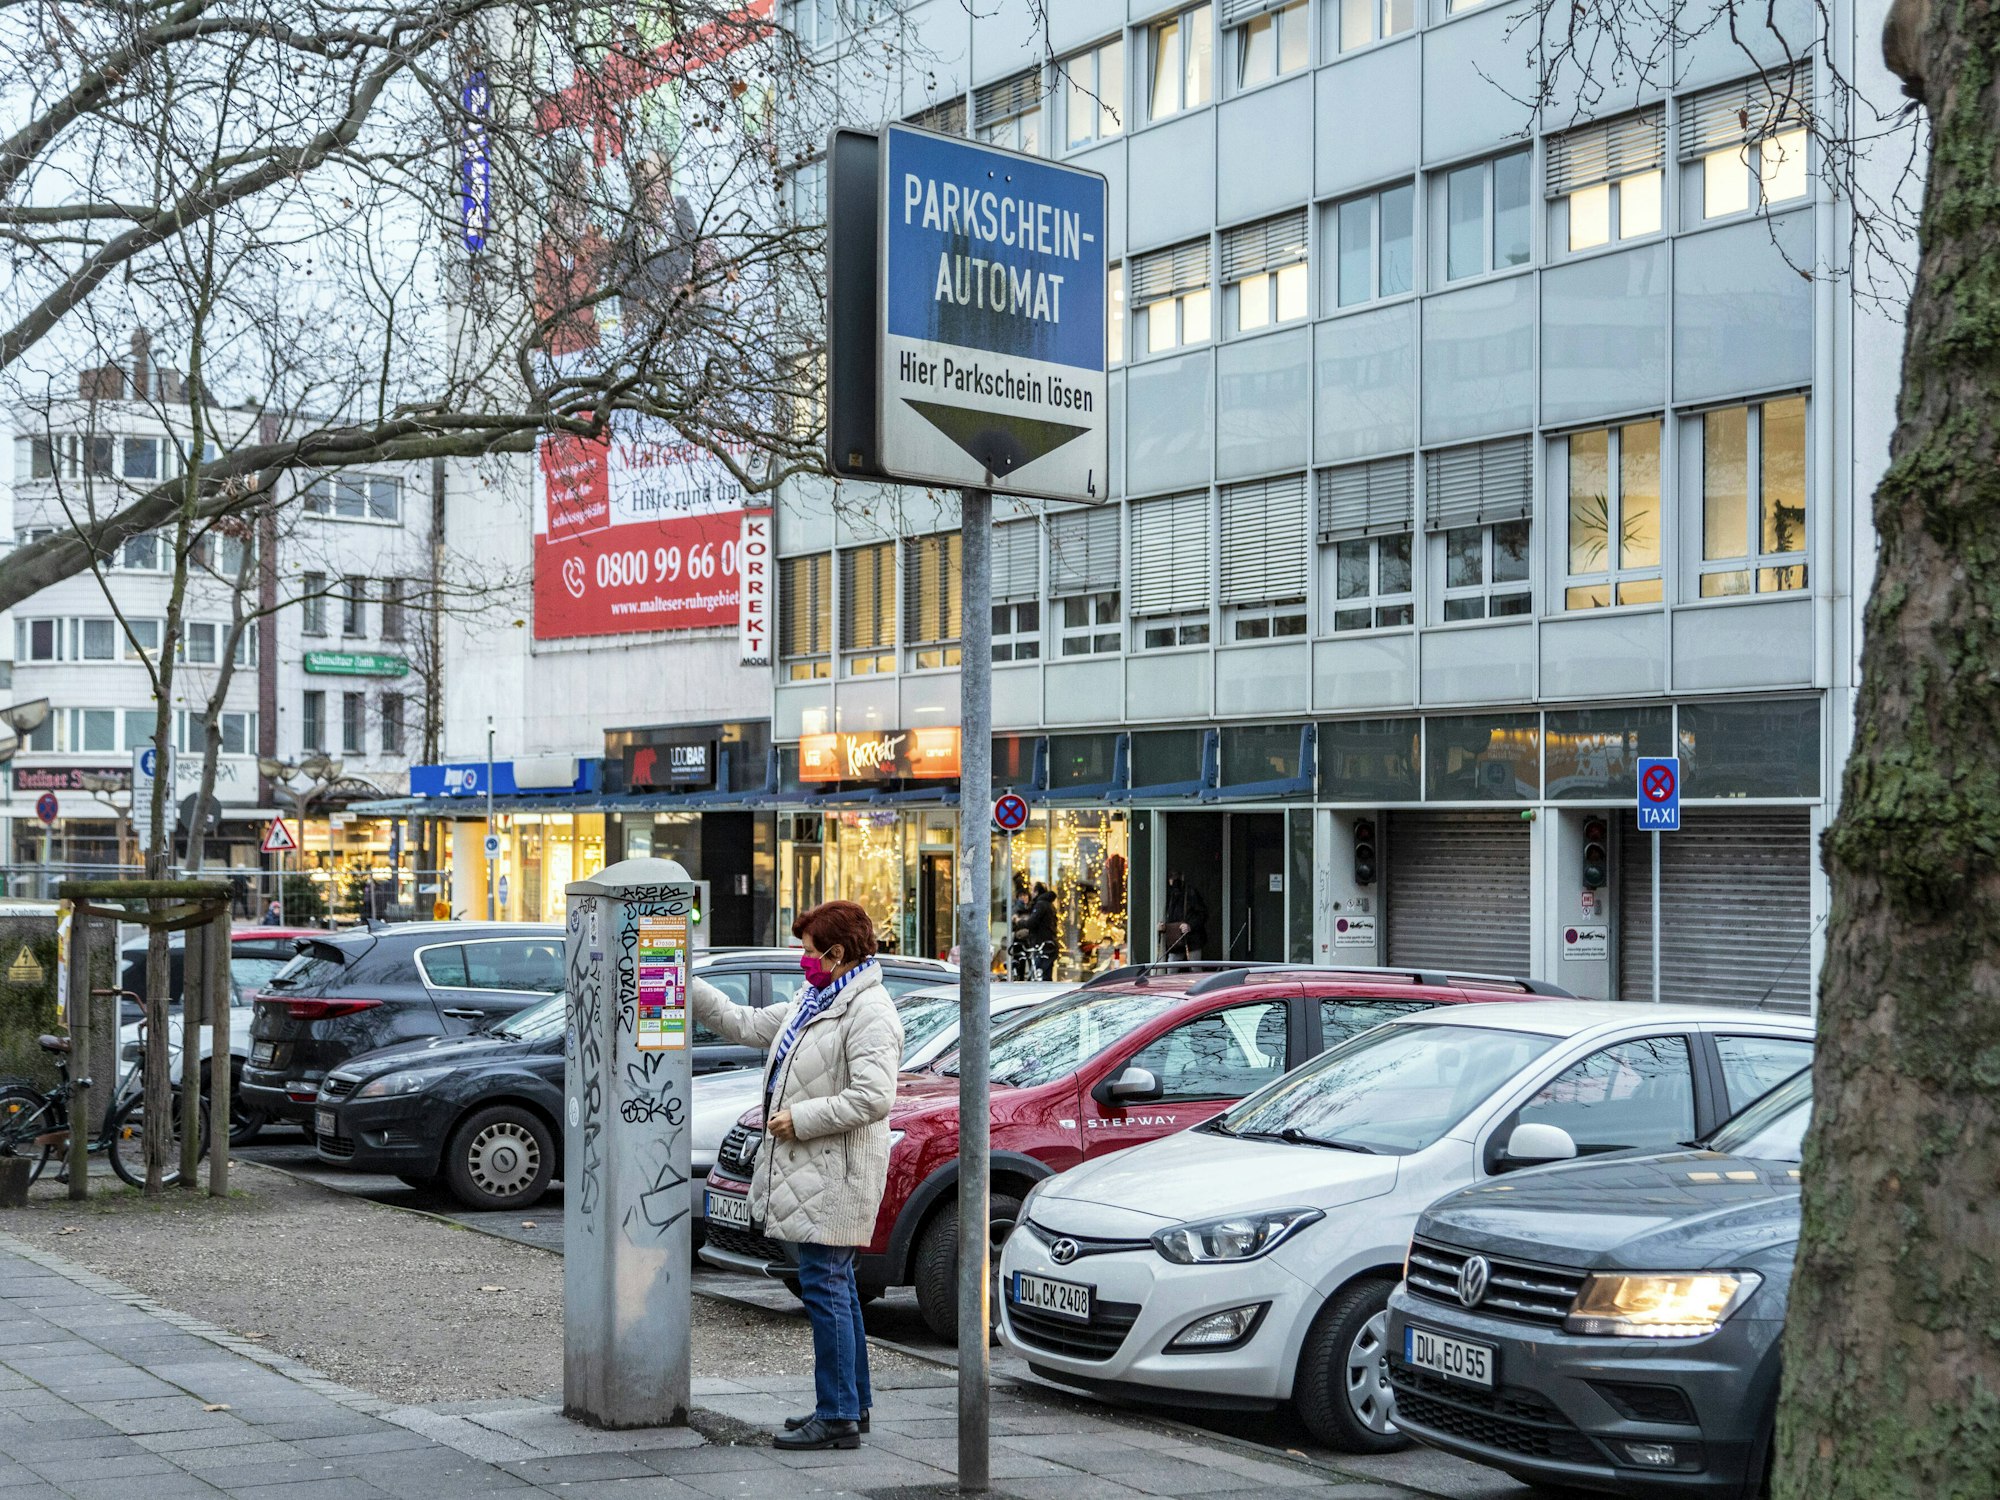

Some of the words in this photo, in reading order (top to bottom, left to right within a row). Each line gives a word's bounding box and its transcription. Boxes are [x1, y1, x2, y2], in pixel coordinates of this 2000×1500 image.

[904, 173, 1095, 261] PARKSCHEIN-
[935, 251, 1064, 324] AUTOMAT
[900, 350, 938, 387] Hier
[943, 357, 1042, 404] Parkschein
[1047, 375, 1093, 413] lösen
[632, 486, 672, 512] Hilfe
[675, 480, 711, 507] rund
[1087, 468, 1096, 498] 4
[596, 549, 649, 589] 0800
[654, 545, 682, 583] 99
[688, 542, 715, 580] 66
[745, 522, 767, 652] KORREKT
[742, 656, 769, 666] MODE
[1642, 807, 1675, 824] TAXI
[1087, 1115, 1176, 1128] STEPWAY
[722, 1198, 733, 1220] CK
[1021, 1278, 1035, 1303] DU
[1043, 1282, 1057, 1308] CK
[1060, 1286, 1088, 1314] 2408
[1416, 1334, 1435, 1366] DU
[1466, 1347, 1486, 1379] 55
